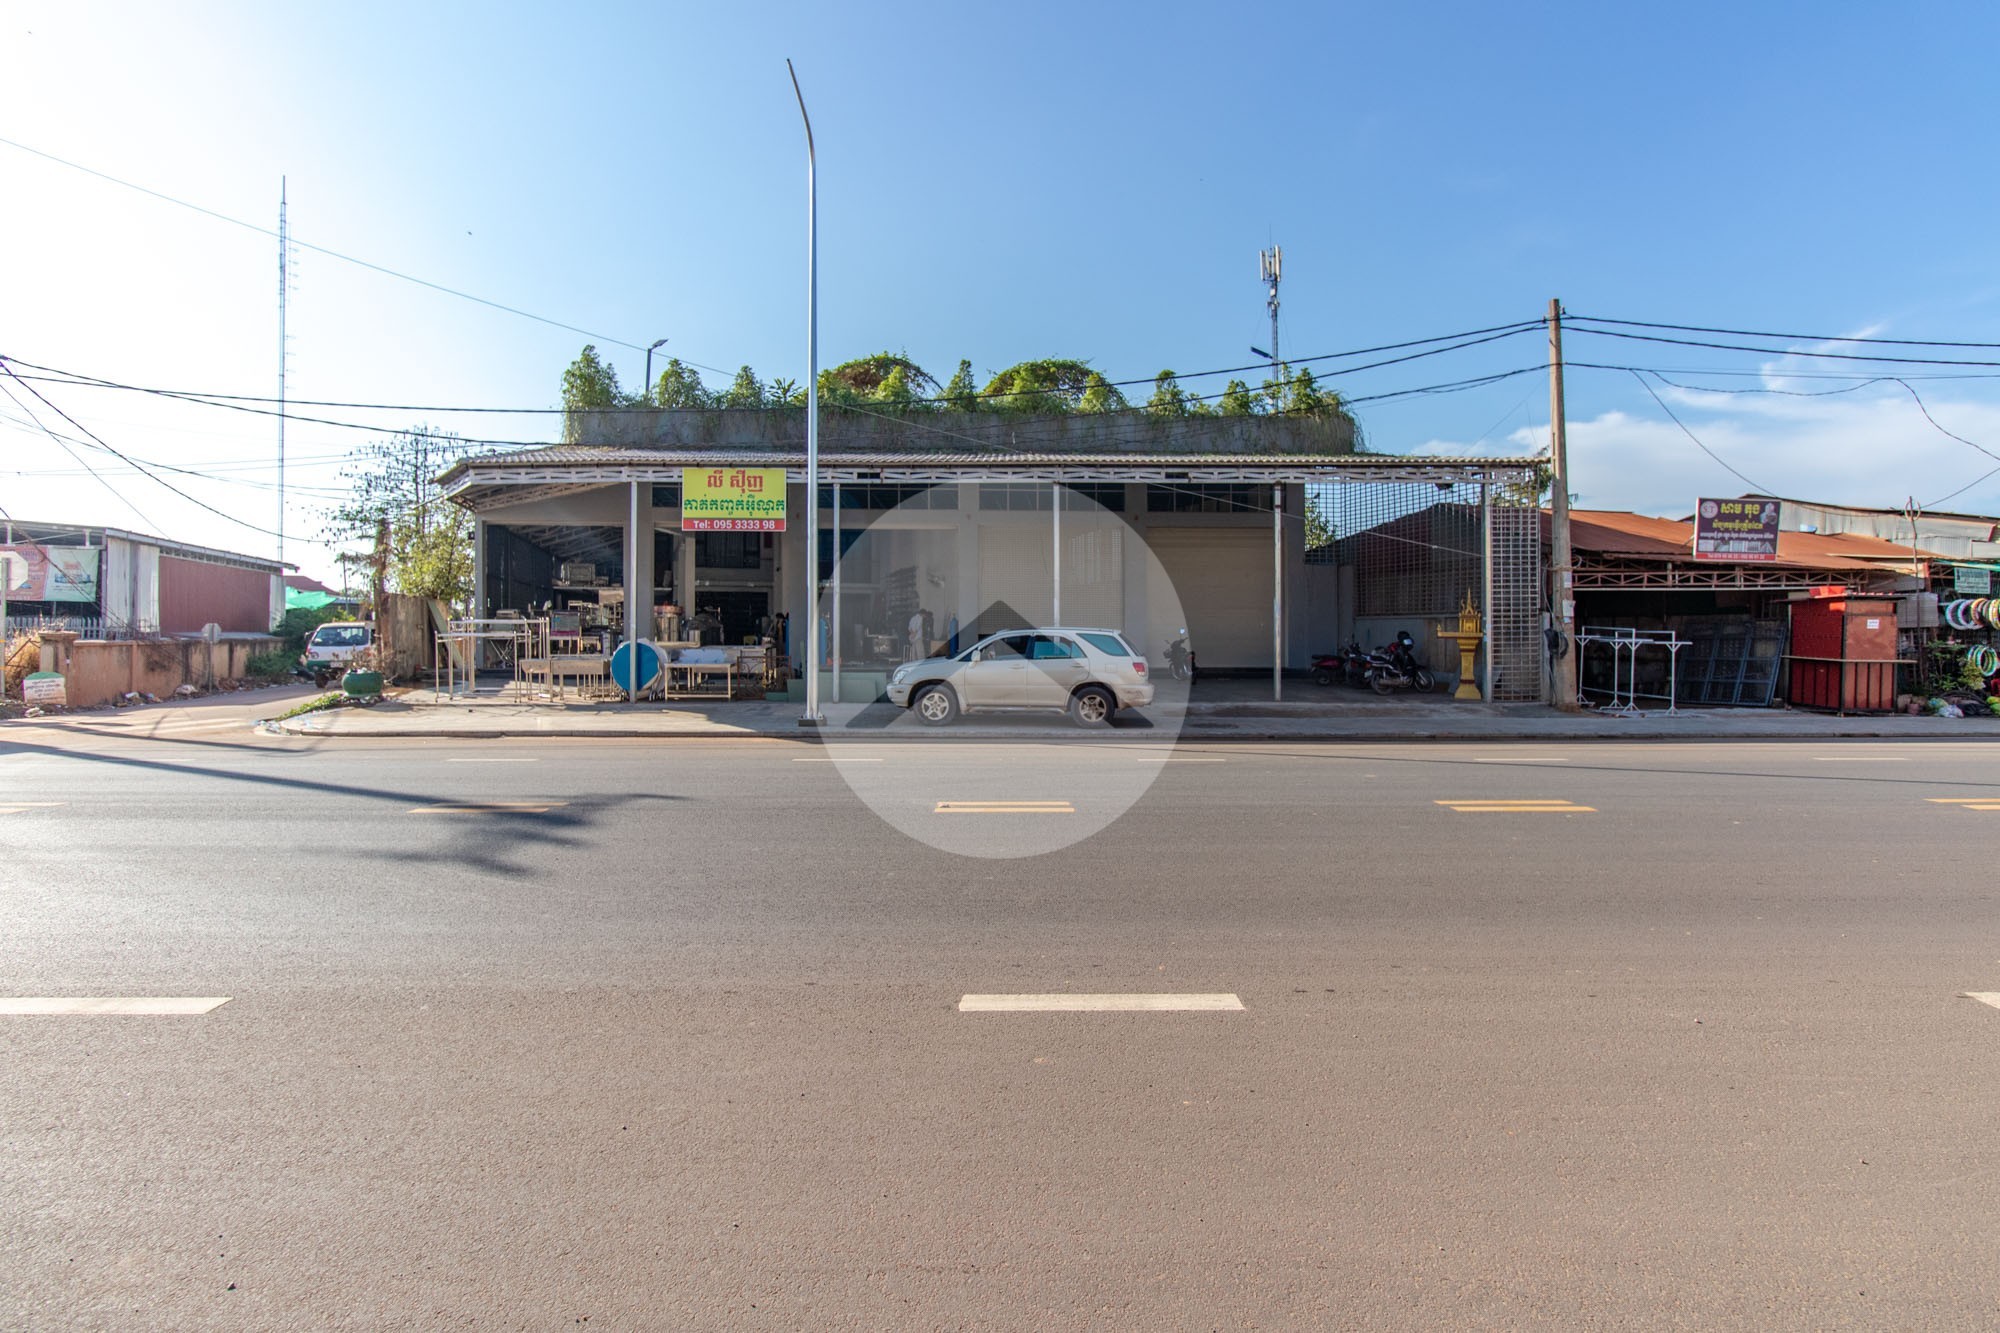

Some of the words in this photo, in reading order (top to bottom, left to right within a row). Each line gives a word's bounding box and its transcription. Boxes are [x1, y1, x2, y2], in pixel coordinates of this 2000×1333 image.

[693, 520, 711, 529] Tel:
[713, 519, 732, 529] 095
[735, 519, 760, 529] 3333
[762, 519, 775, 529] 98
